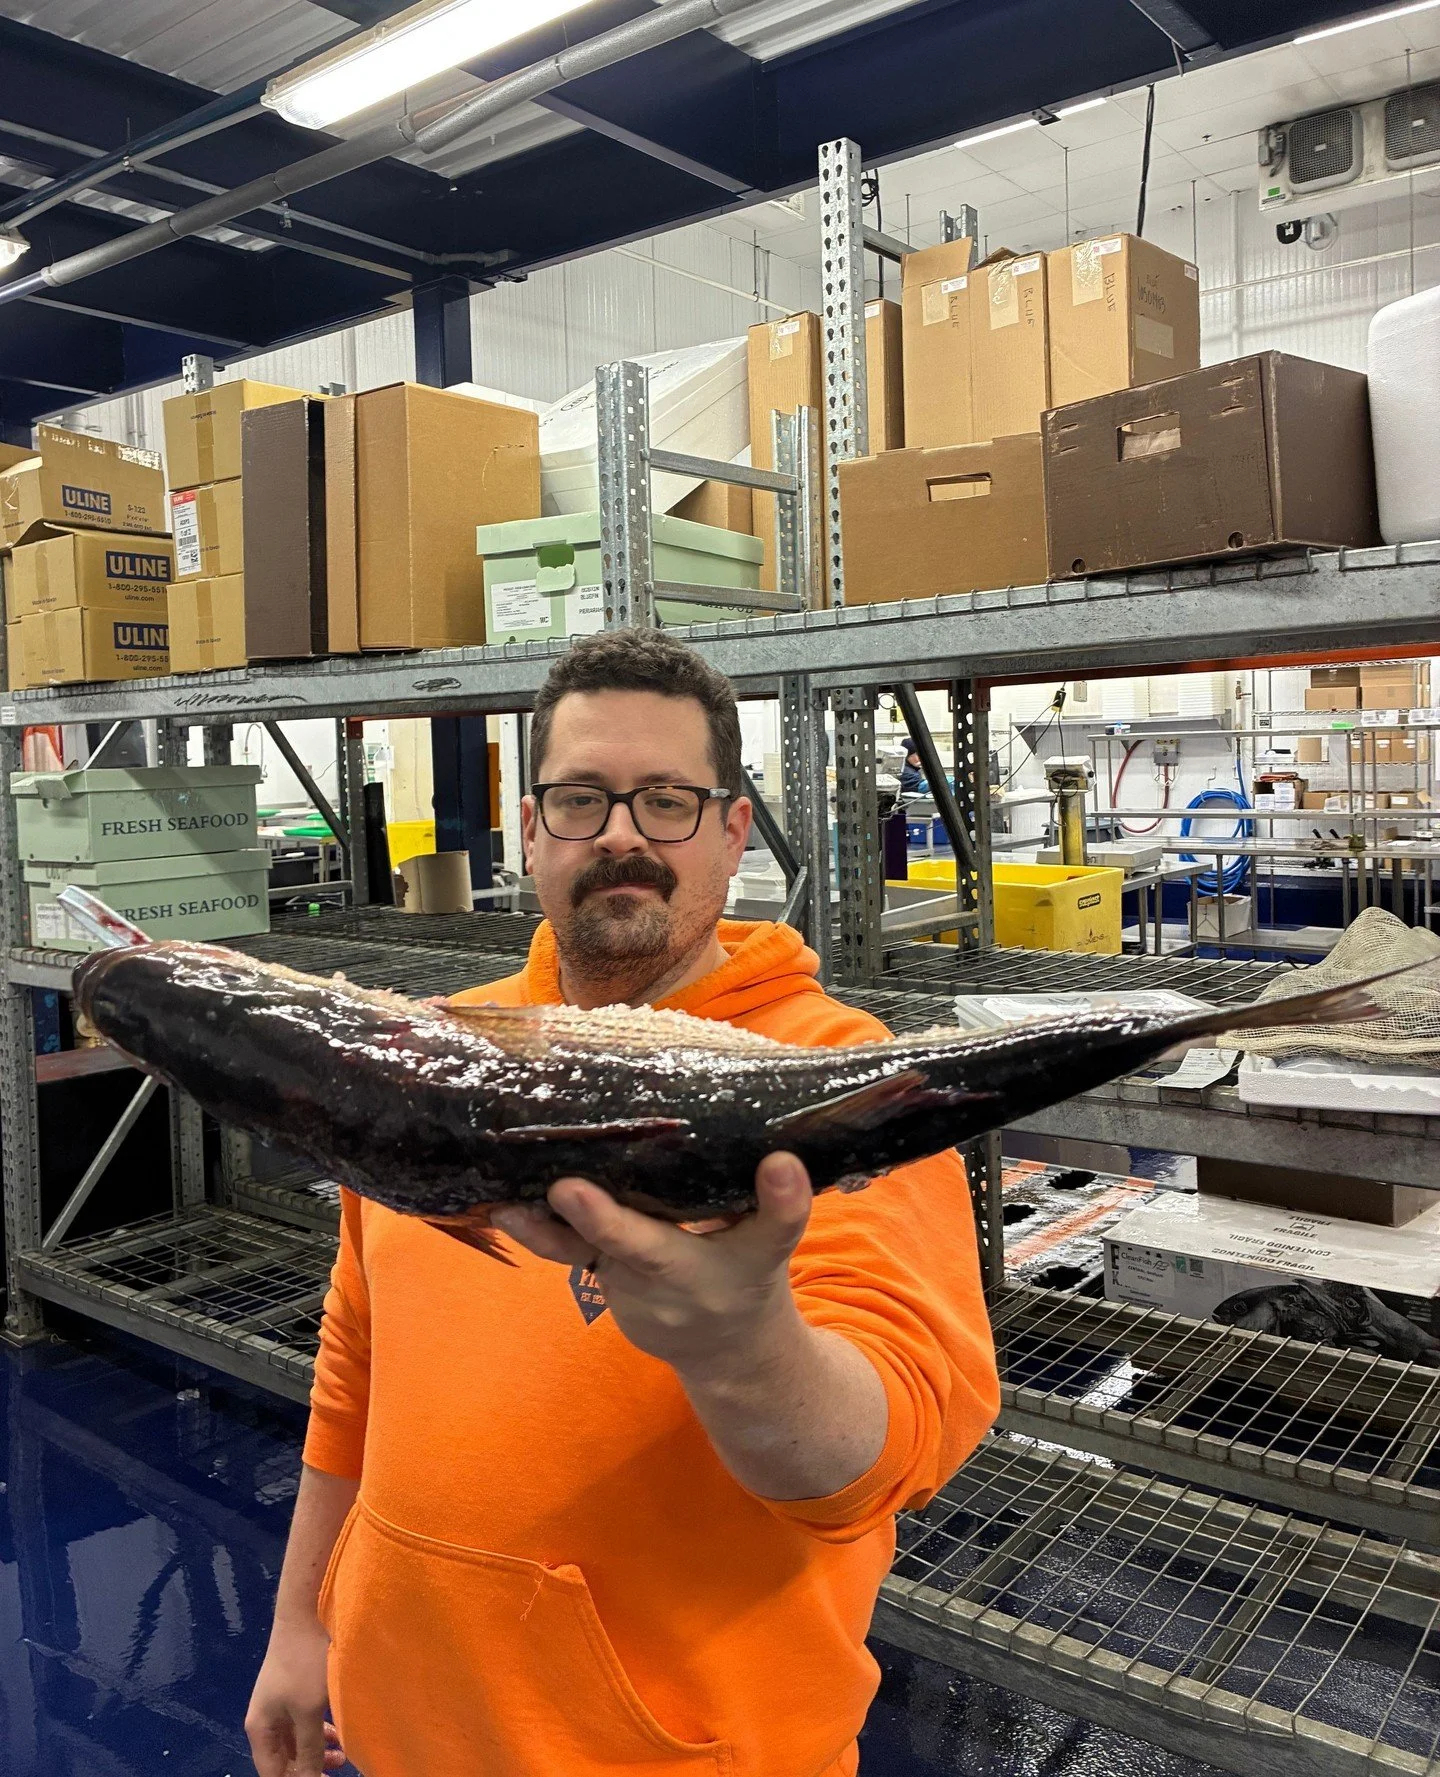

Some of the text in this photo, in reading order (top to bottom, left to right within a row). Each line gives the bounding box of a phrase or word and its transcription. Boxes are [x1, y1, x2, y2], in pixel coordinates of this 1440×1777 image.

[1103, 272, 1117, 312] BLUE
[1022, 287, 1036, 328] BLUE
[65, 488, 110, 511] ULINE
[109, 555, 168, 578] ULINE
[125, 594, 155, 603] uline.com
[102, 812, 249, 836] FRESH SEAFOOD
[115, 894, 260, 922] RESH SEAFOOD
[1289, 1215, 1333, 1226] FRAGILE
[1273, 1227, 1318, 1239] FRAGILE
[1211, 1247, 1275, 1264] CONTENIDO
[1266, 1241, 1331, 1257] CONTENIDO
